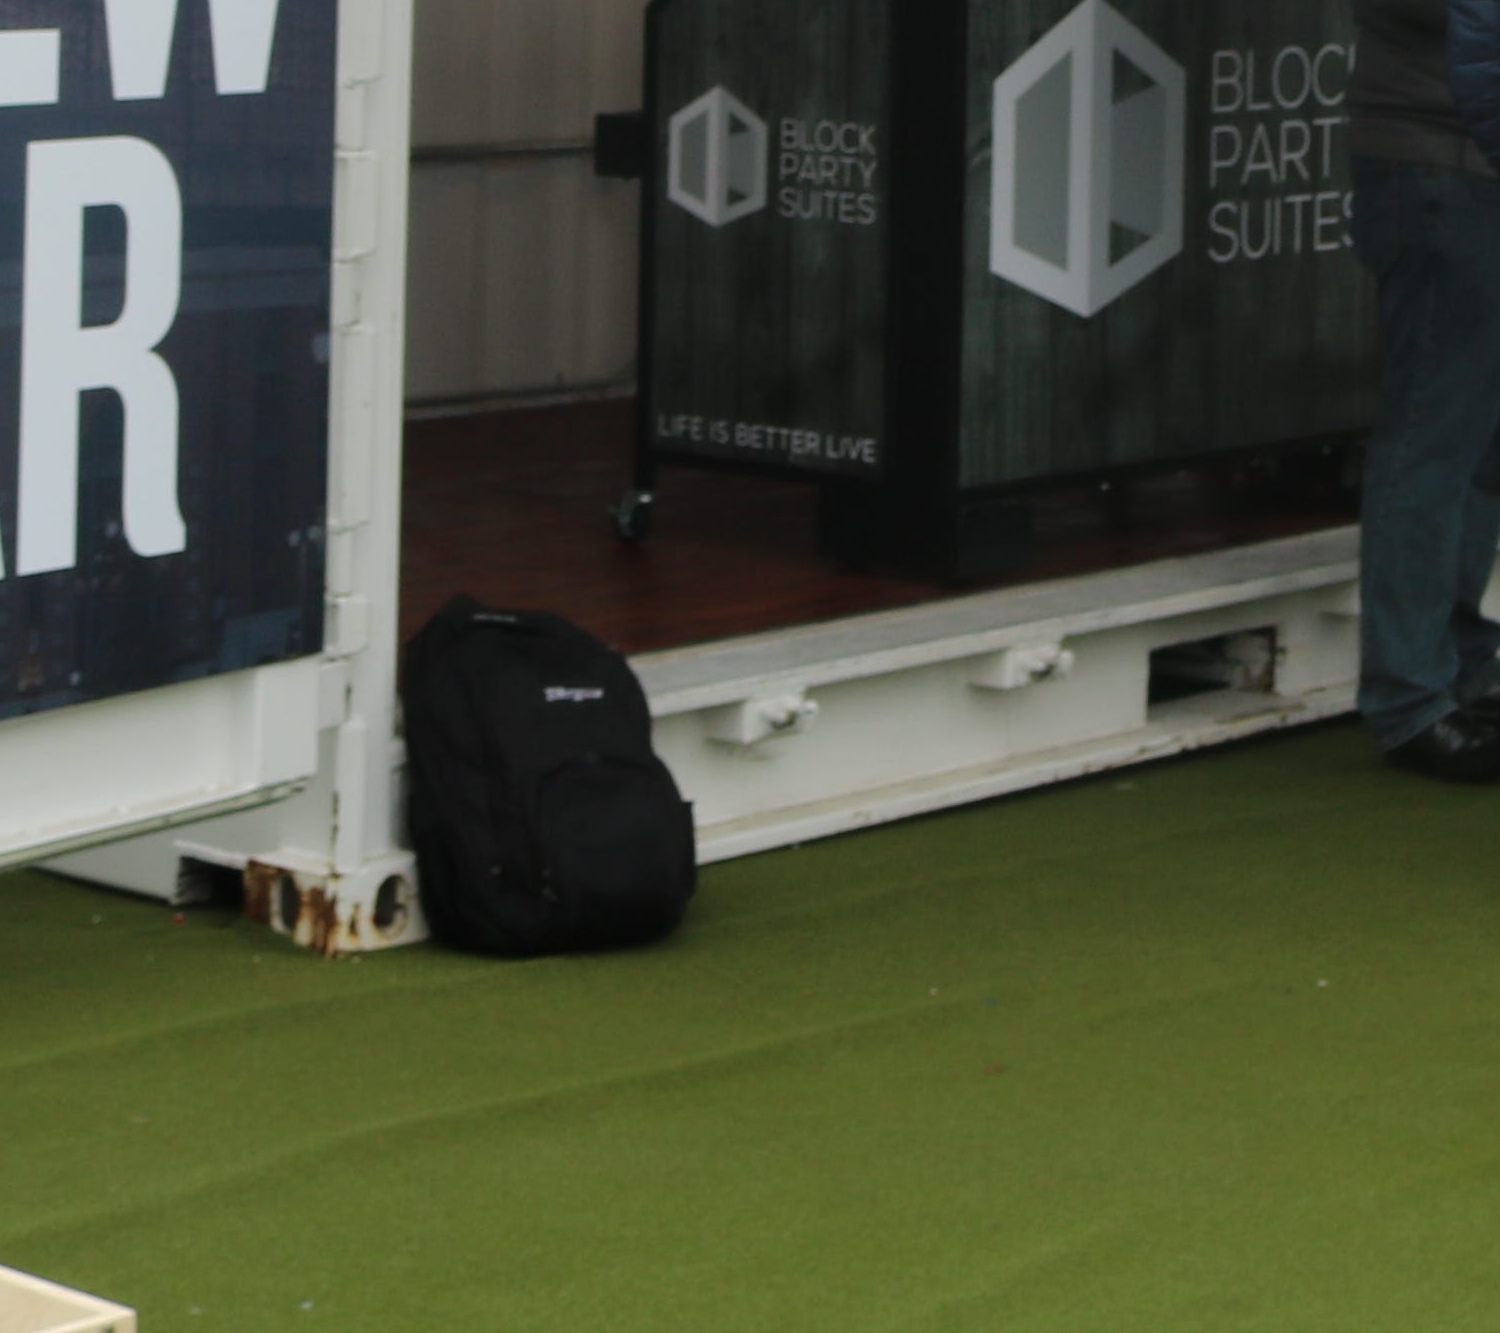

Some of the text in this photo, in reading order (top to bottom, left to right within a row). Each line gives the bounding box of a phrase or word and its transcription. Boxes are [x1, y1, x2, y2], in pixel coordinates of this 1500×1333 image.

[779, 117, 877, 157] BLOCK
[1209, 116, 1351, 189] PART
[779, 151, 878, 189] PARTY
[778, 186, 877, 226] SUITES
[657, 413, 878, 465] LIFE IS BETTER LIVE
